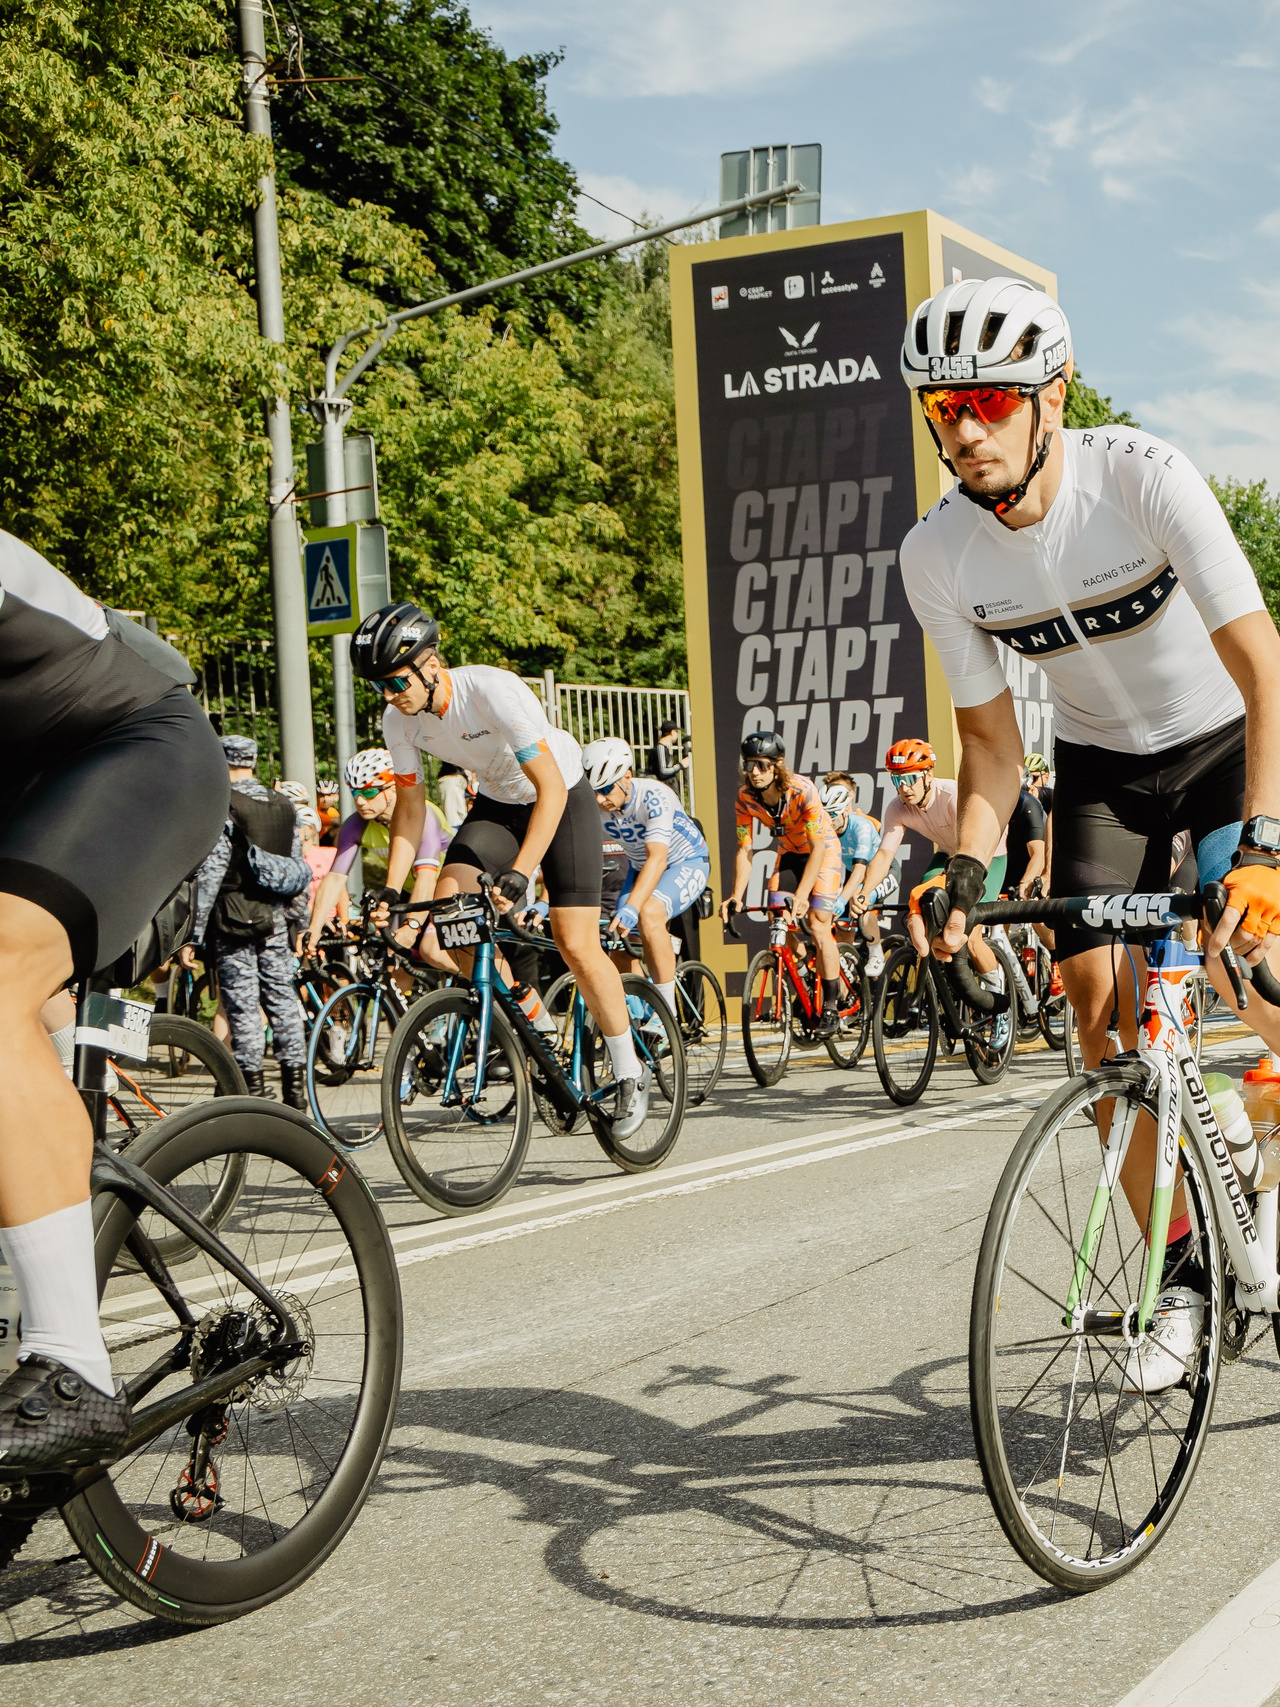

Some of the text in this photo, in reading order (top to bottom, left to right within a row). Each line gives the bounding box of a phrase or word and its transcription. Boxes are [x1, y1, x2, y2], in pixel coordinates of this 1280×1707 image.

[724, 355, 881, 399] LA STRADA
[931, 356, 973, 380] 3455
[726, 402, 889, 490] СТАРТ
[1082, 433, 1174, 469] RYSEL
[730, 477, 892, 562] СТАРТ
[1082, 557, 1147, 588] RACING TEAM
[733, 550, 896, 634] СТАРТ
[985, 599, 1012, 609] DESIGNED
[994, 603, 1024, 615] FLANDERS
[996, 632, 1048, 649] AN
[736, 623, 899, 705] СТАРТ
[875, 873, 899, 899] RCA
[1081, 893, 1176, 929] 3455
[441, 920, 481, 948] 3432
[123, 1004, 152, 1035] 3582
[1179, 1056, 1257, 1245] cannondale
